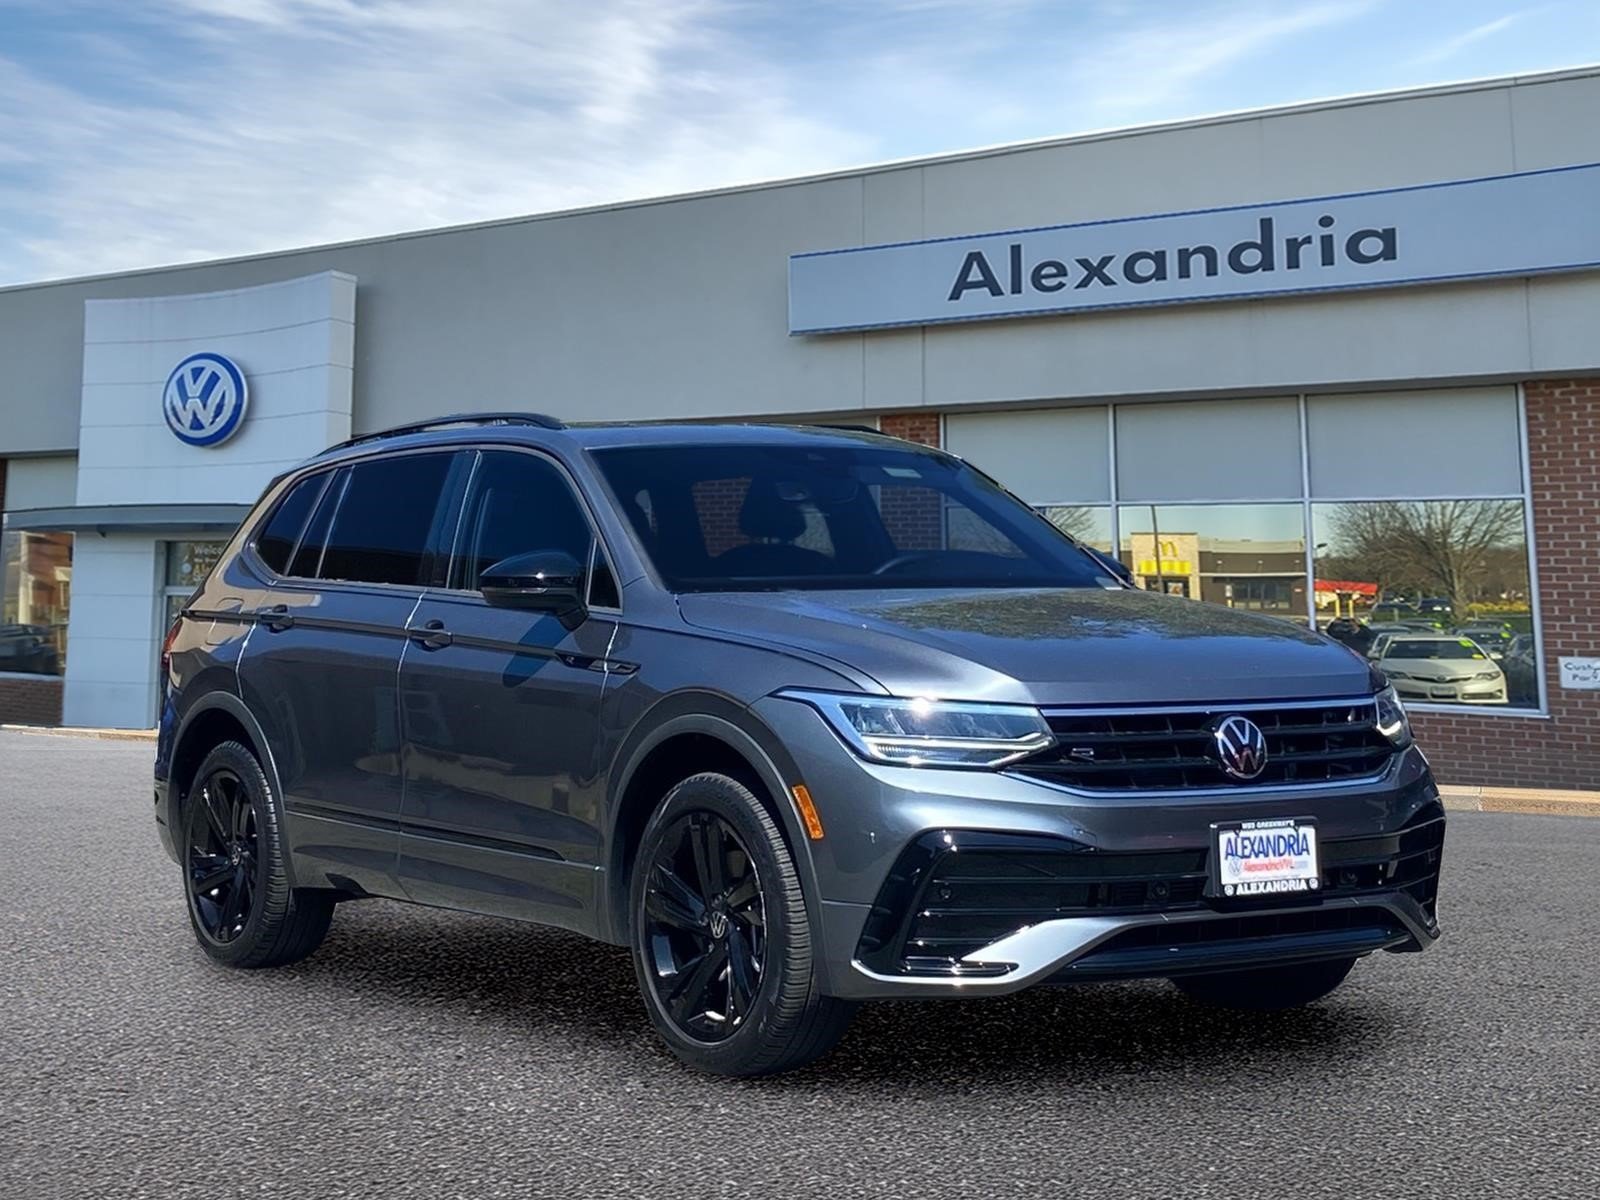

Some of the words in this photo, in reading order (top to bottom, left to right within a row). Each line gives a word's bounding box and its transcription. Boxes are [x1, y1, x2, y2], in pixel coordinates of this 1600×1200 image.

[947, 215, 1398, 301] Alexandria
[163, 352, 247, 446] VW
[1225, 833, 1310, 861] ALEXANDRIA
[1236, 879, 1309, 896] ALEXANDRIA
